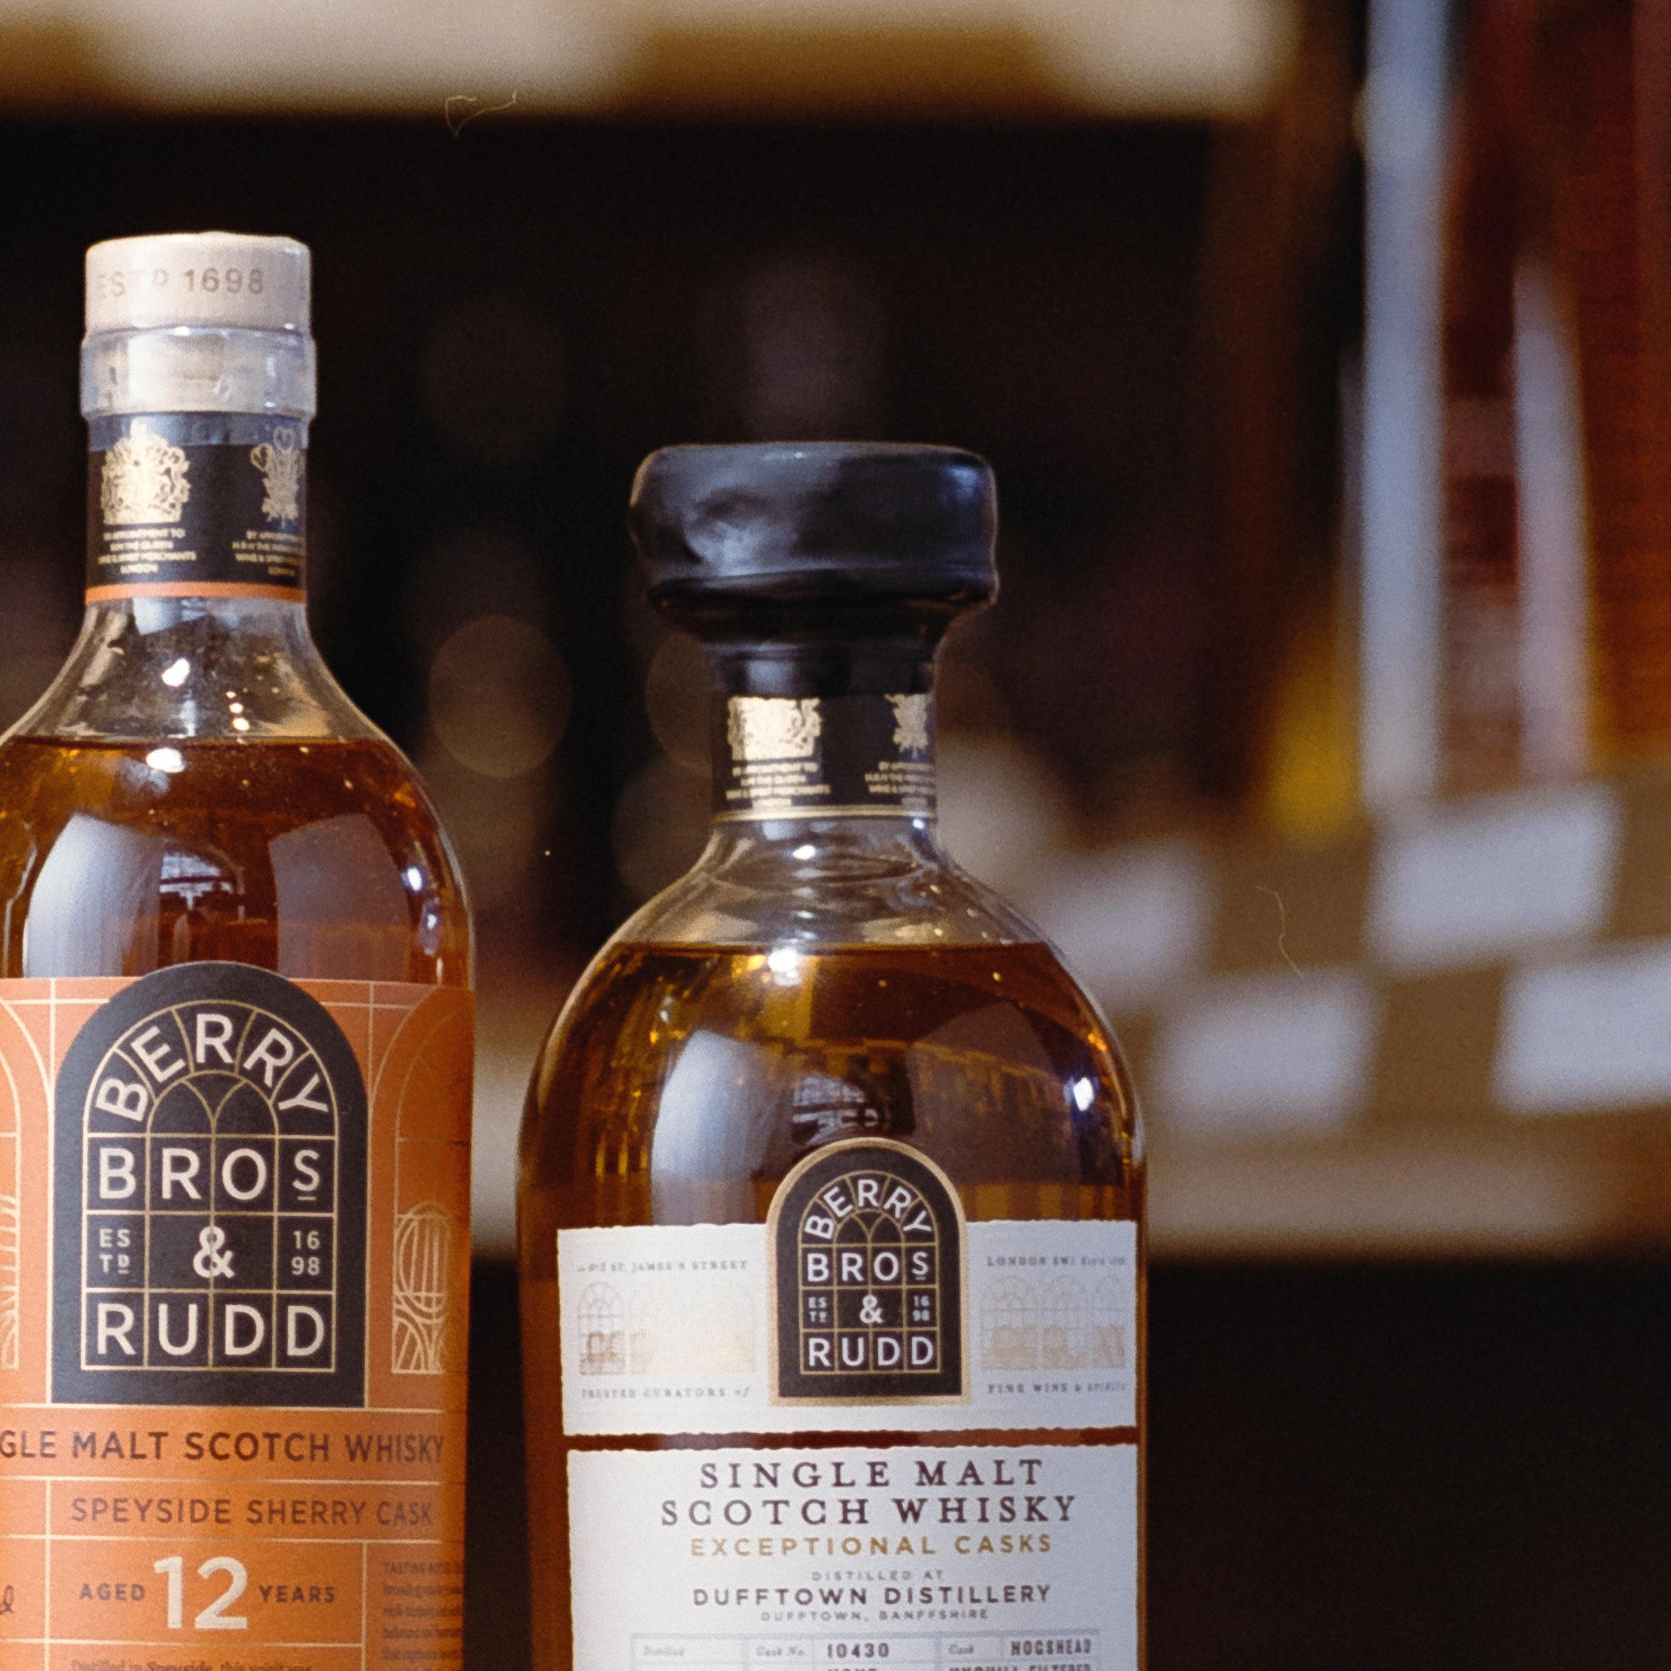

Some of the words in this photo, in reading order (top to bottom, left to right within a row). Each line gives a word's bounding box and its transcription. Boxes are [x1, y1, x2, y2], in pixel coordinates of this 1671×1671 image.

[183, 267, 264, 295] 1698
[95, 1013, 329, 1122] BERRY
[98, 1148, 321, 1200] BROS
[805, 1178, 934, 1240] BERRY
[193, 1227, 235, 1279] &
[806, 1251, 928, 1282] BROS
[859, 1295, 883, 1324] &
[97, 1304, 325, 1357] RUDD
[808, 1336, 933, 1366] RUDD
[72, 1431, 169, 1461] MALT
[185, 1432, 330, 1463] SCOTCH
[345, 1434, 444, 1464] WHISKY
[700, 1462, 890, 1489] SINGLE
[916, 1459, 1043, 1485] MALT
[71, 1498, 231, 1525] SPEYSIDE
[246, 1499, 366, 1526] SHERRY
[376, 1501, 433, 1526] CASK
[661, 1498, 869, 1526] SCOTCH
[893, 1495, 1076, 1523] WHISKY
[690, 1536, 936, 1557] EXCEPTIONAL
[954, 1534, 1052, 1553] CASKS
[79, 1583, 146, 1602] AGED
[153, 1556, 248, 1629] 12
[259, 1586, 335, 1604] YEARS
[693, 1587, 868, 1606] DUFFTOWN
[884, 1585, 1050, 1605] DISTILLERY
[825, 1643, 889, 1659] 10430
[1011, 1639, 1091, 1656] HOGSHEAD
